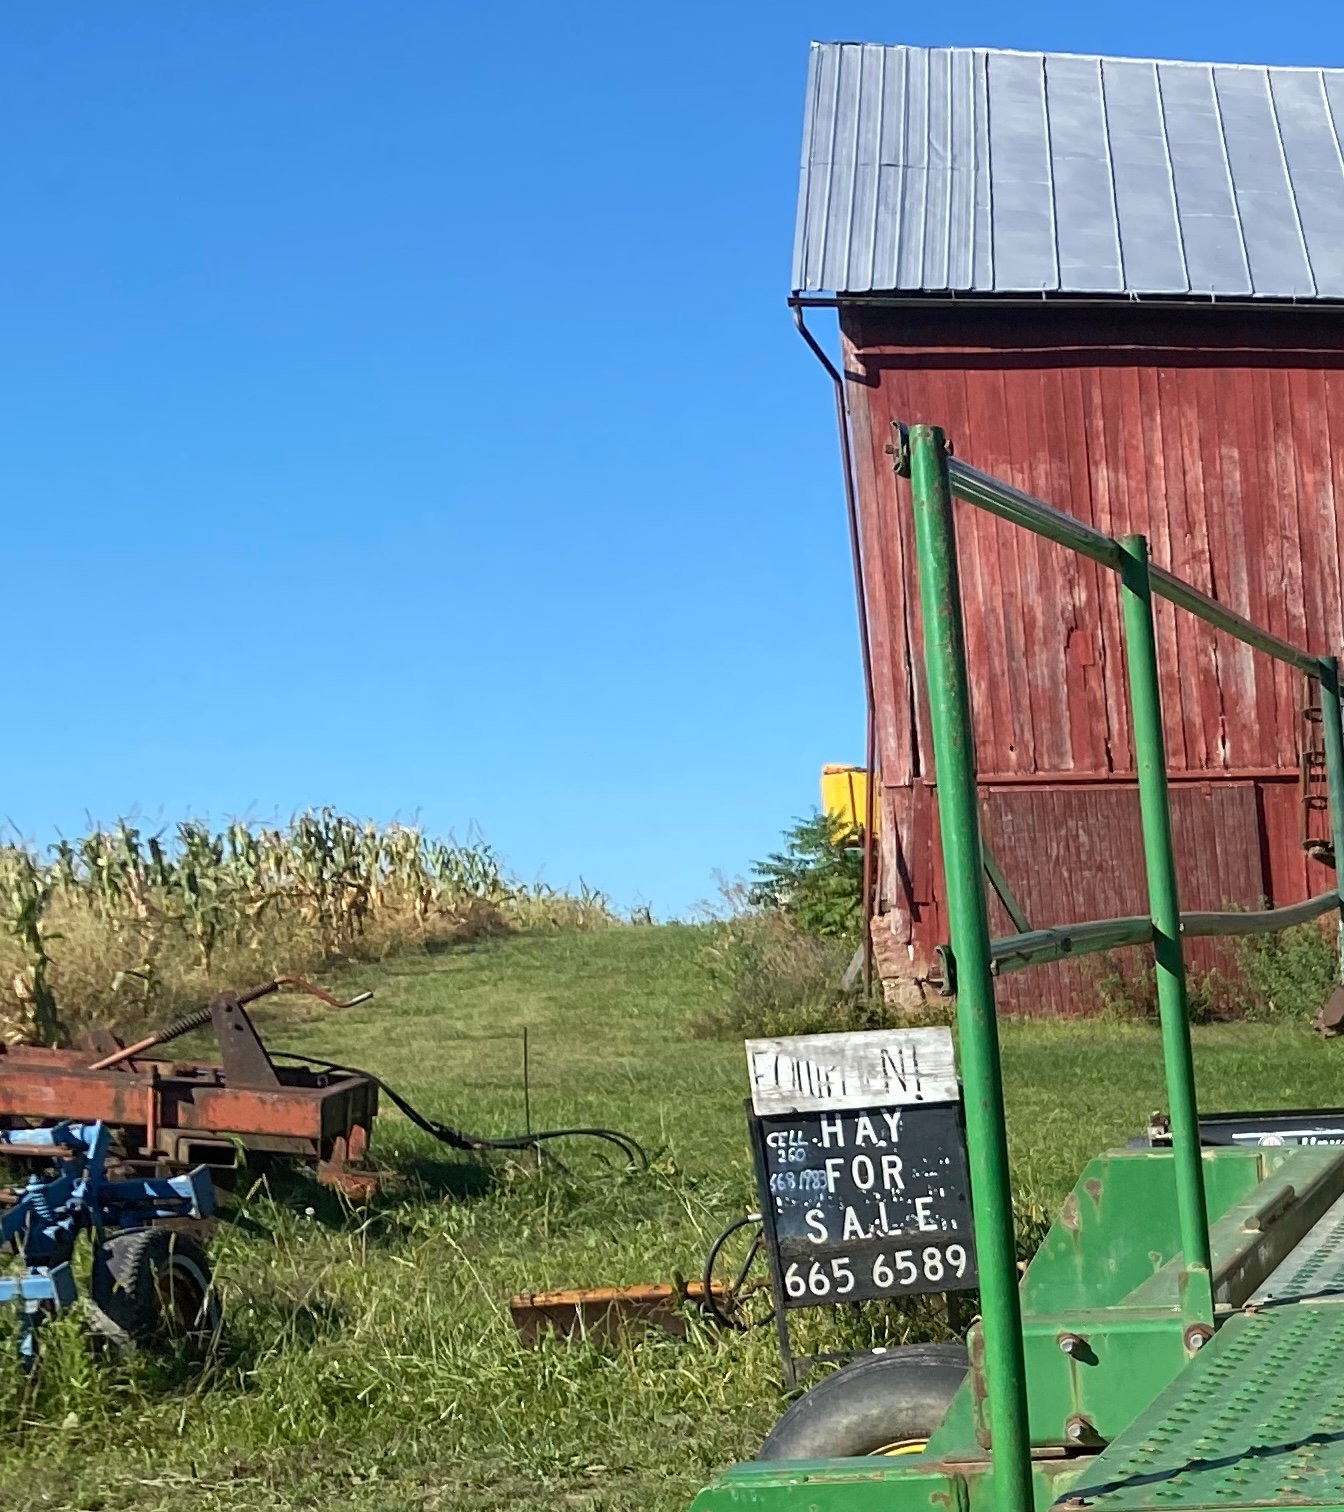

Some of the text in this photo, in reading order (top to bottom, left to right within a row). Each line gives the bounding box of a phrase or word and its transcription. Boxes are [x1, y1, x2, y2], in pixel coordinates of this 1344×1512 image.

[766, 1130, 808, 1147] CELL
[820, 1107, 902, 1148] HAY
[825, 1154, 905, 1193] FOR
[805, 1196, 938, 1244] SALE
[785, 1244, 966, 1298] 665 6589
